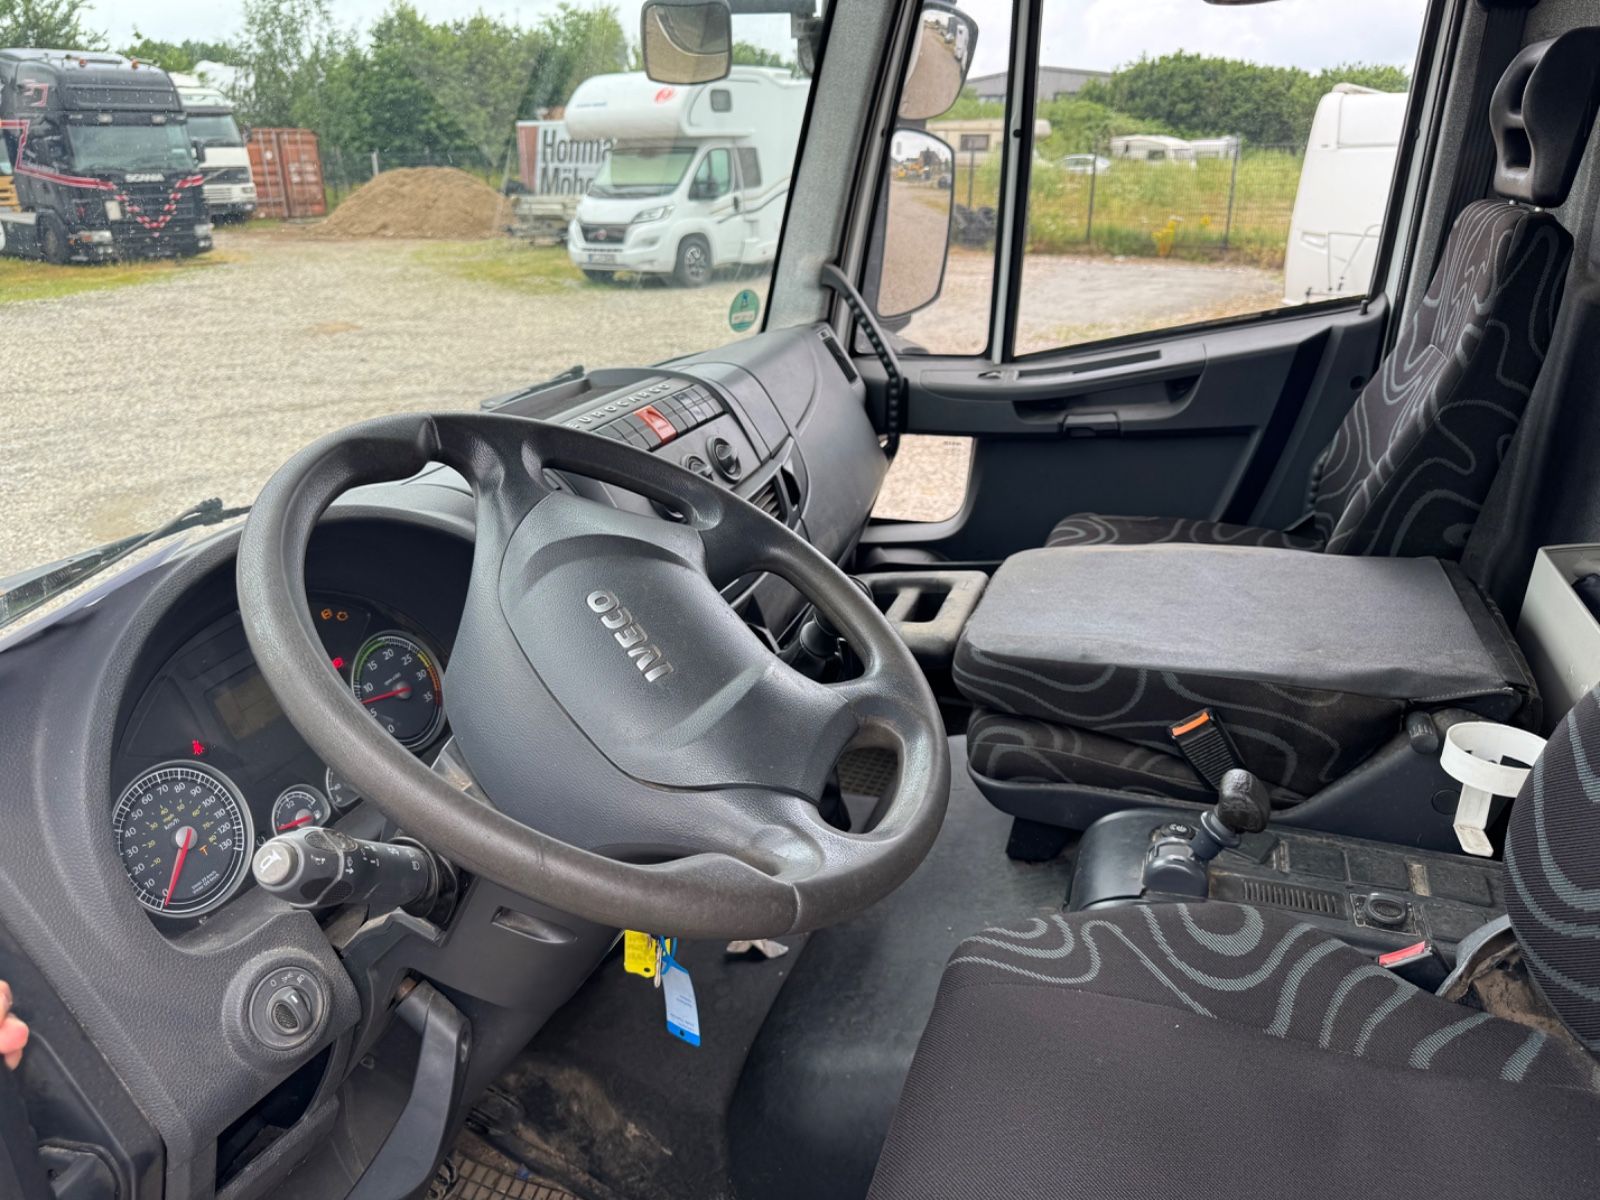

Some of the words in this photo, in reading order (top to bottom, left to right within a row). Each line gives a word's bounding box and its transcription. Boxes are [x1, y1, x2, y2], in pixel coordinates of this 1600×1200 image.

[125, 173, 165, 182] SCANIA
[586, 590, 674, 683] IVECO
[382, 649, 394, 660] 20
[401, 654, 412, 665] 25
[367, 660, 378, 671] 15
[416, 669, 426, 680] 30
[363, 682, 373, 693] 10
[388, 724, 395, 733] 0
[156, 784, 169, 796] 70
[174, 782, 186, 793] 80
[190, 786, 202, 797] 90
[141, 794, 153, 805] 60
[202, 796, 216, 807] 100
[131, 809, 143, 821] 50
[213, 808, 226, 820] 110
[164, 817, 180, 831] km/h
[217, 822, 231, 834] 120
[124, 827, 137, 839] 40
[219, 839, 232, 851] 130
[126, 846, 139, 858] 30
[133, 863, 145, 875] 20
[144, 878, 155, 889] 10
[162, 888, 169, 896] 0
